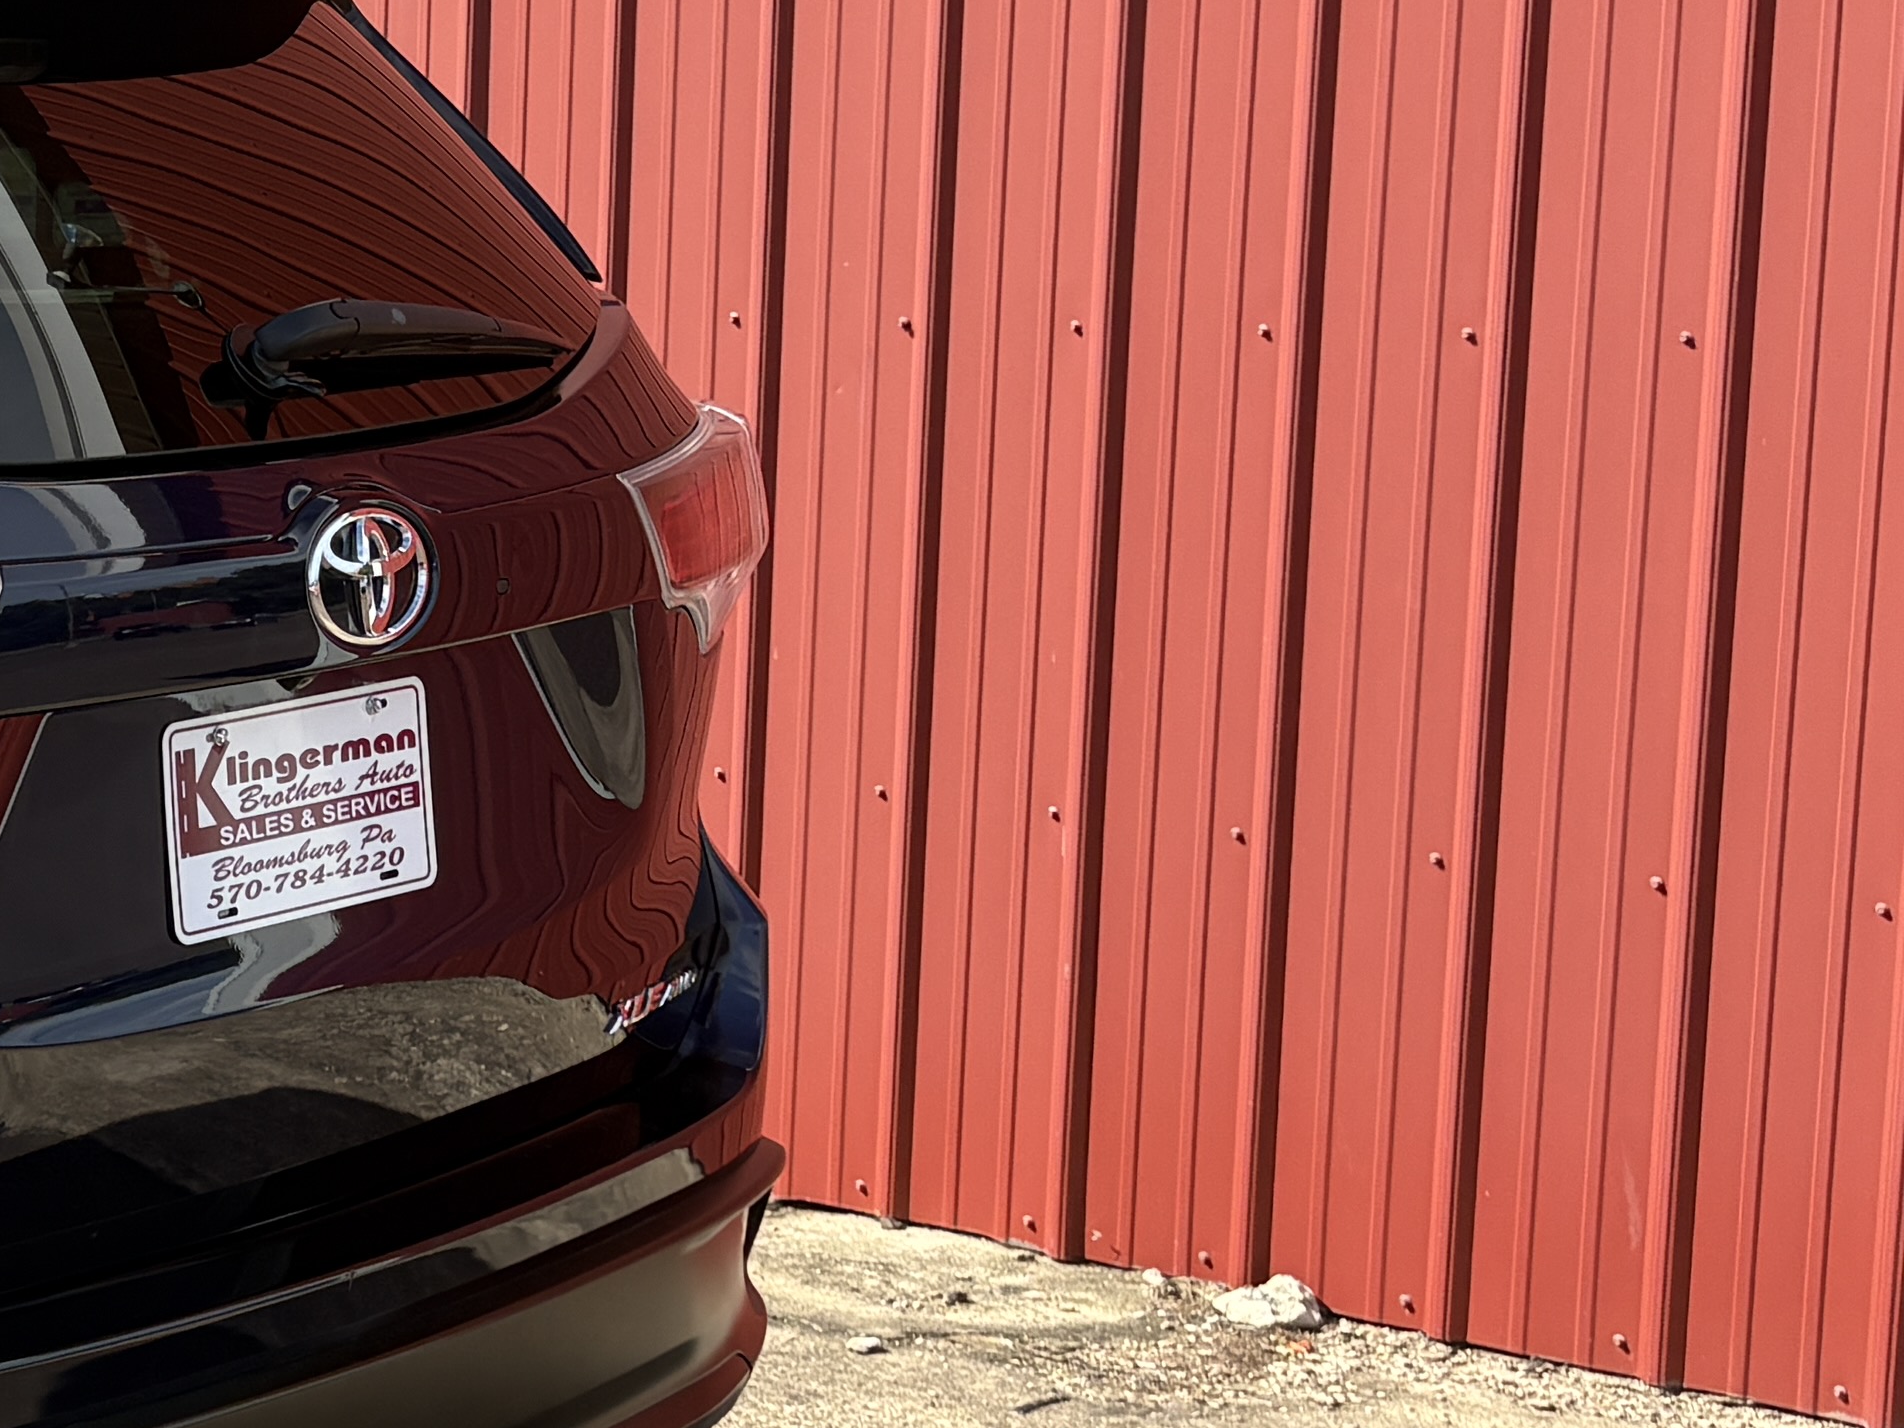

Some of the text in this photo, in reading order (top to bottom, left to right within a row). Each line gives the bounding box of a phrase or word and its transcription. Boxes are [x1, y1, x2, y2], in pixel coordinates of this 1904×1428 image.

[174, 727, 417, 859] Klingerman
[219, 786, 415, 846] SALES & SERVICE
[238, 759, 417, 813] Brothers Auto
[206, 846, 405, 910] 570-784-4220
[211, 822, 397, 882] Bloomsburg Pa
